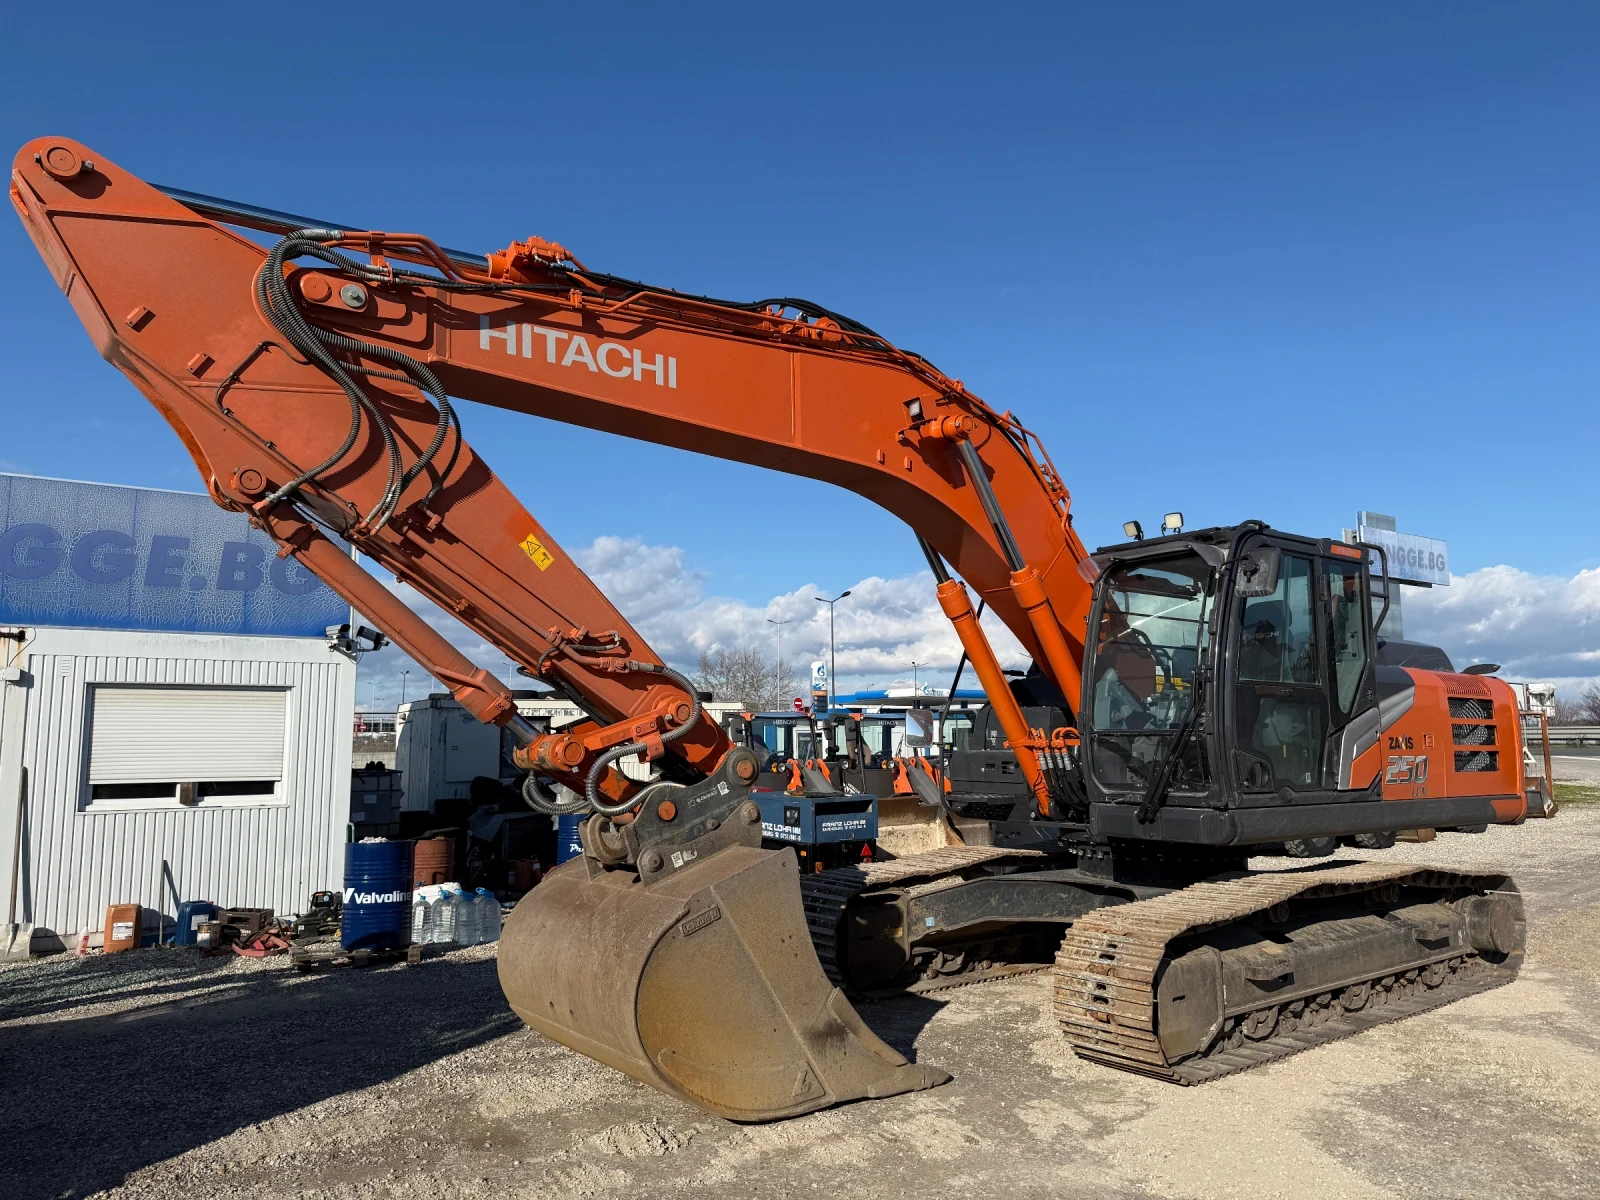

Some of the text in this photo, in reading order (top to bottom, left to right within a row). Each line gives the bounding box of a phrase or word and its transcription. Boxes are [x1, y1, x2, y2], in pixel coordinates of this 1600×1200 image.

[479, 315, 678, 389] HITACHI
[1385, 755, 1428, 784] 250
[354, 890, 412, 905] Valvoline
